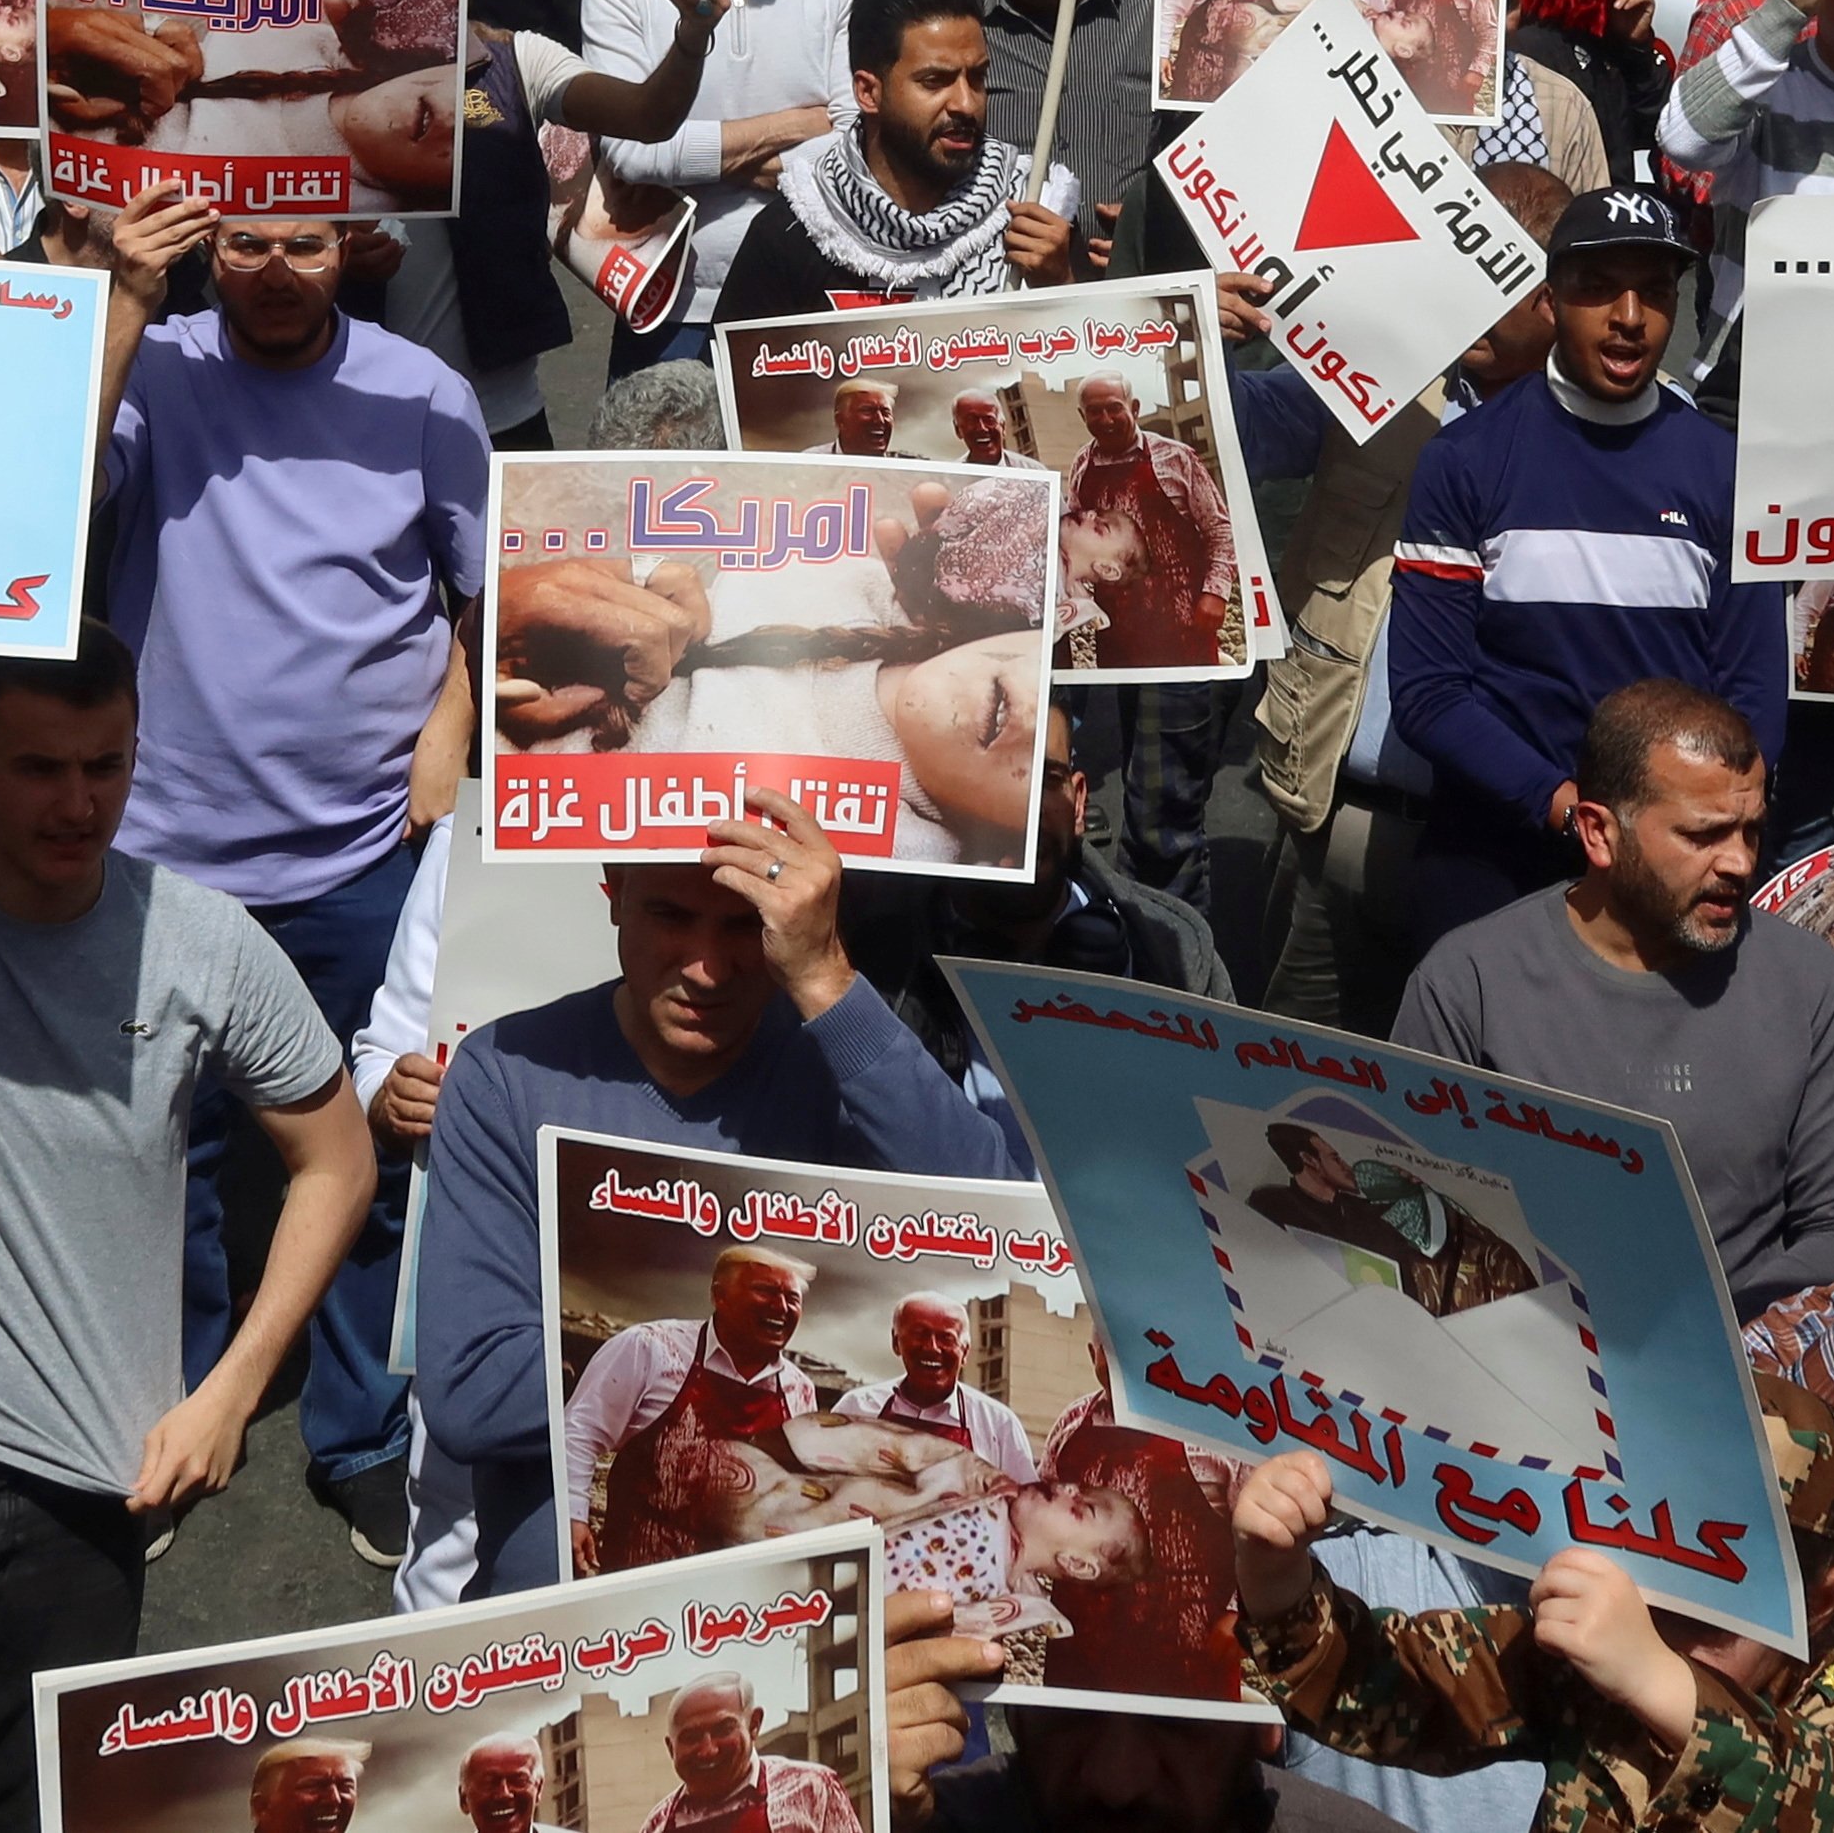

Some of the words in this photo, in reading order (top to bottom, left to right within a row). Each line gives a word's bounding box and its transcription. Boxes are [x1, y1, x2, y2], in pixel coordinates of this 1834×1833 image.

[626, 476, 872, 571] امريكا
[1660, 510, 1689, 526] FILA
[497, 775, 585, 839] غزة
[600, 761, 748, 843] أطفال
[1010, 994, 1221, 1051] المتحضر
[1235, 1035, 1389, 1094] العالم
[1404, 1078, 1477, 1130] إلى
[1484, 1083, 1646, 1175] رسالة
[1143, 1328, 1408, 1492] المقاومة
[1431, 1463, 1542, 1544] مع
[1561, 1469, 1755, 1584] كلنا
[565, 1619, 676, 1679] حرب
[681, 1586, 829, 1655] مجرموا
[264, 1665, 415, 1740] الأطفال
[423, 1640, 566, 1713] يقتلون
[97, 1691, 258, 1758] والنساء
